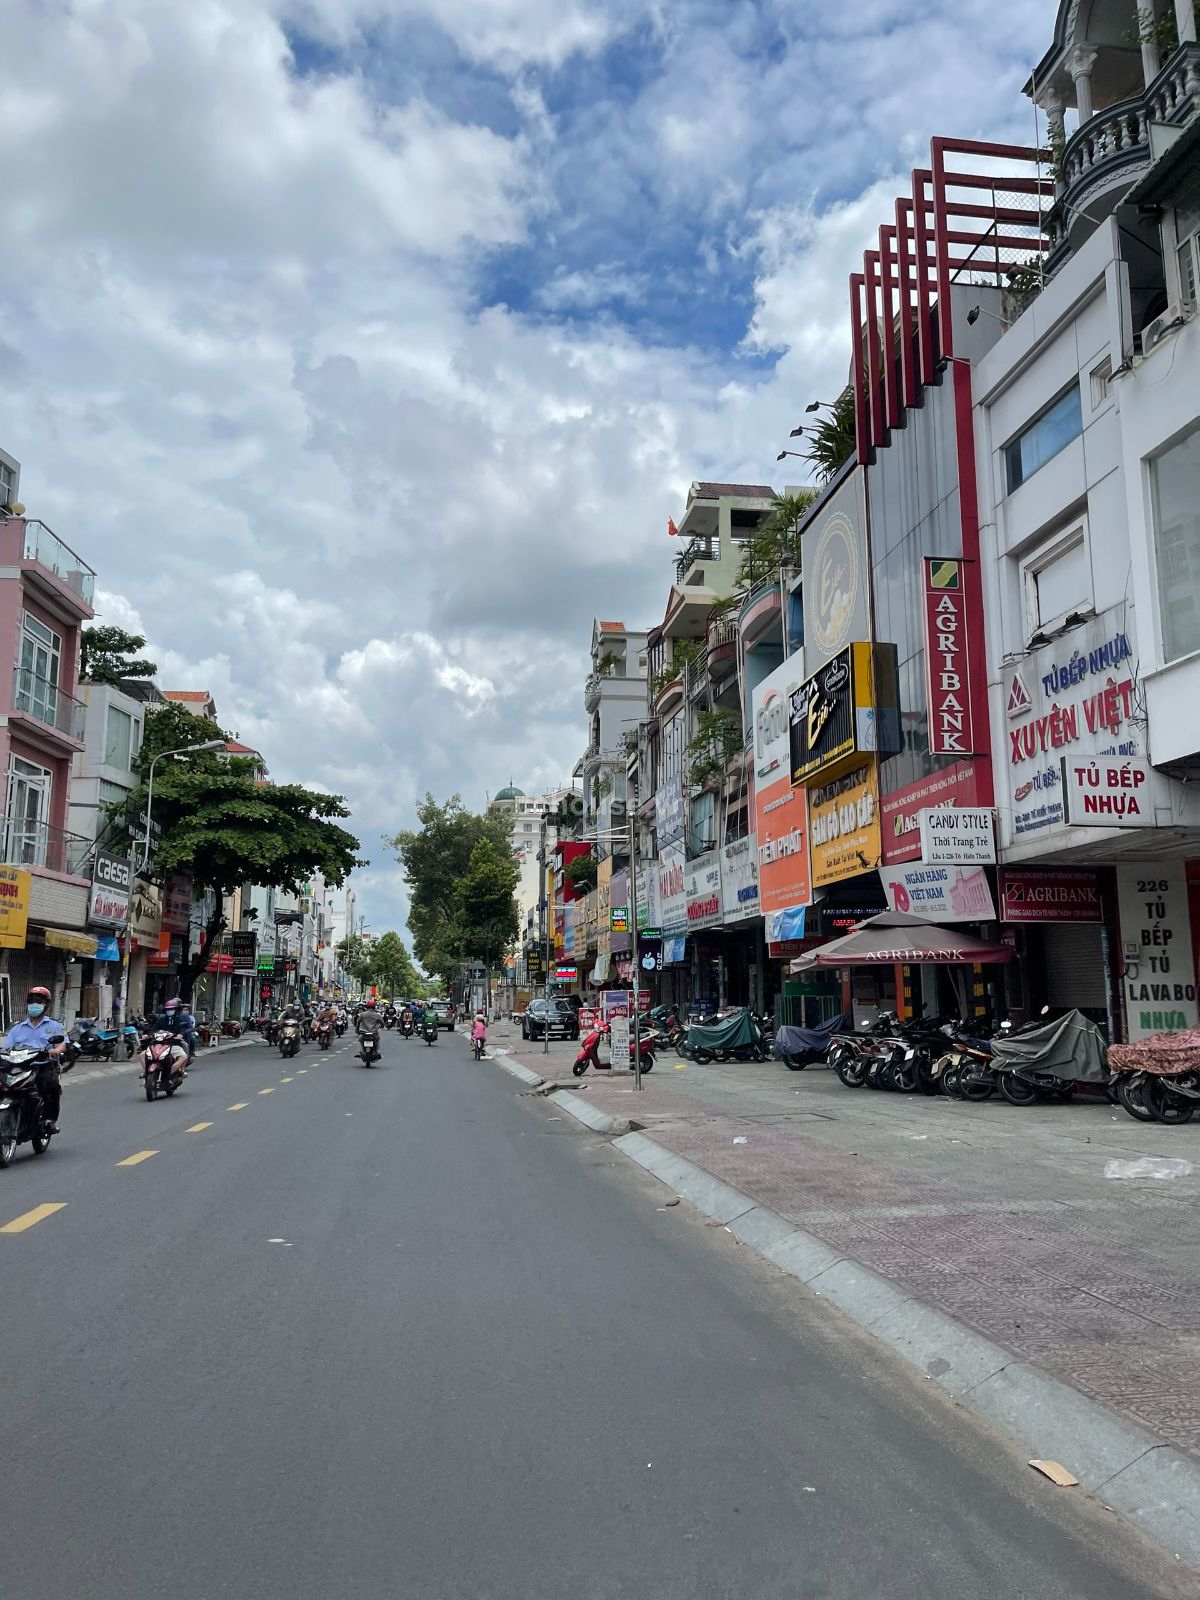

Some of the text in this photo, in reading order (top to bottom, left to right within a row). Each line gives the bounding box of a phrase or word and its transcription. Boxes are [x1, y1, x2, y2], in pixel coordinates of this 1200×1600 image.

[1088, 633, 1133, 675] NHỰA
[935, 594, 966, 751] AGRIBANK
[1010, 677, 1134, 765] XUYÊN VIỆT
[1074, 762, 1145, 788] TỦ BẾP
[1084, 792, 1140, 819] NHỰA
[928, 814, 959, 829] CANDY
[962, 814, 989, 829] STYLE
[932, 835, 988, 849] Thời Trang Trẻ
[905, 866, 948, 885] NGÂN HÀNG
[1137, 880, 1169, 893] 226
[909, 886, 944, 901] VIỆT NAM
[1027, 887, 1098, 902] AGRIBANK
[1145, 896, 1166, 919] TỦ
[1141, 921, 1173, 946] BẾP
[865, 949, 966, 961] AGRIBANK
[1149, 950, 1170, 973] TỦ
[1139, 1010, 1188, 1034] NHỰA
